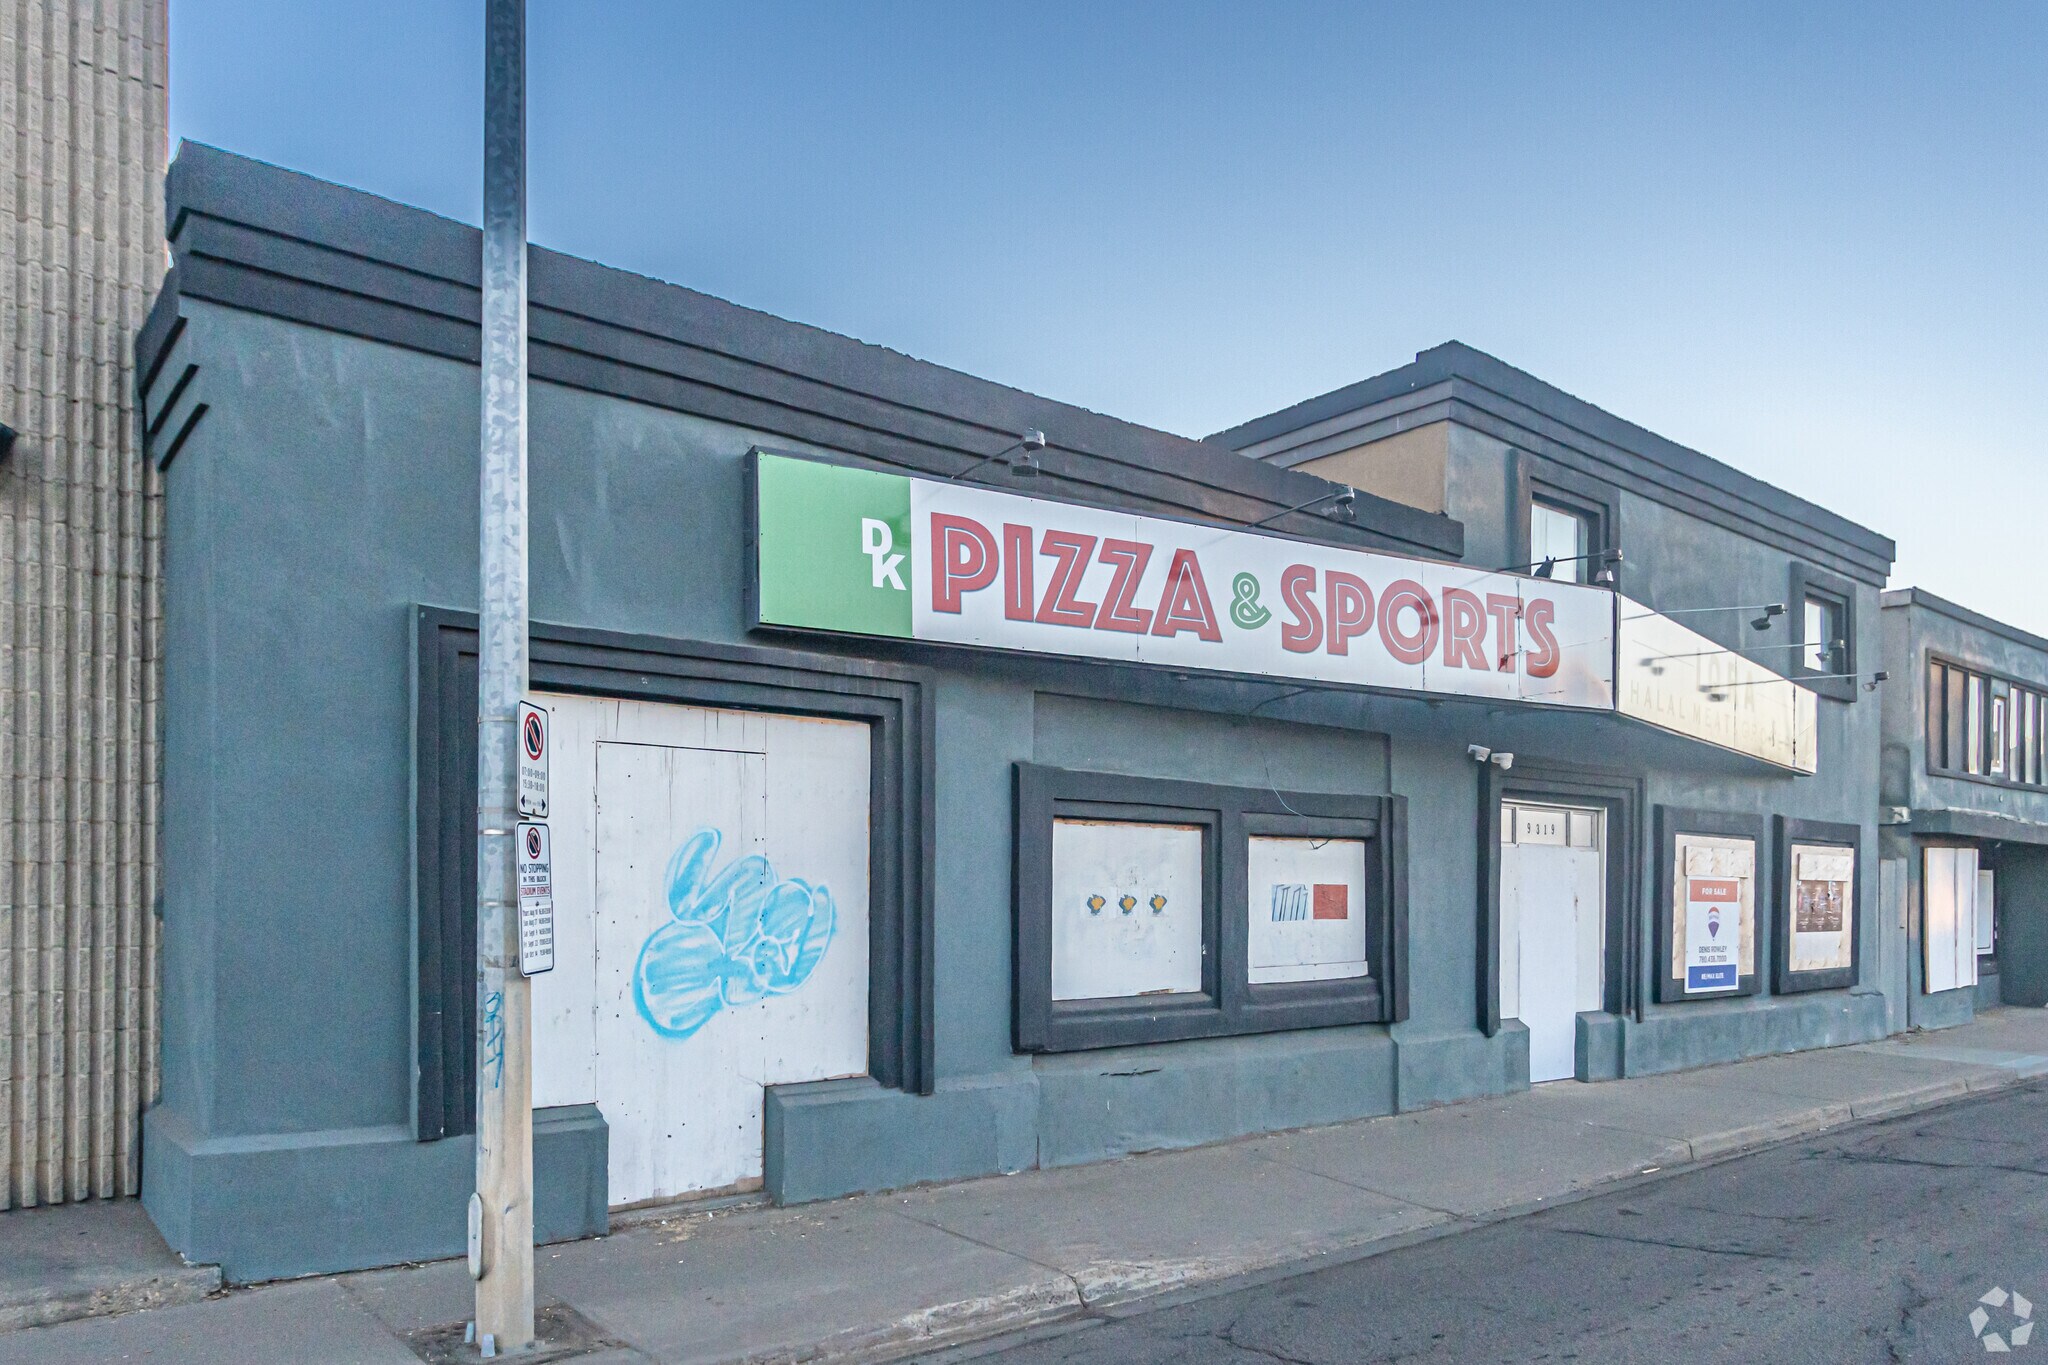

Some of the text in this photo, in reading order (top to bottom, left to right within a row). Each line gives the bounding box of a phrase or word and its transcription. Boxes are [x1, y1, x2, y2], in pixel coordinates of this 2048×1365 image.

[930, 511, 1560, 678] PIZZA & SPORTS
[1527, 822, 1555, 835] 9319
[520, 863, 549, 874] NO STOPPING
[528, 875, 536, 883] THIS
[537, 875, 547, 883] BLOCK
[520, 886, 550, 896] STADIUM EVENTS
[1701, 887, 1727, 896] FOR SALE
